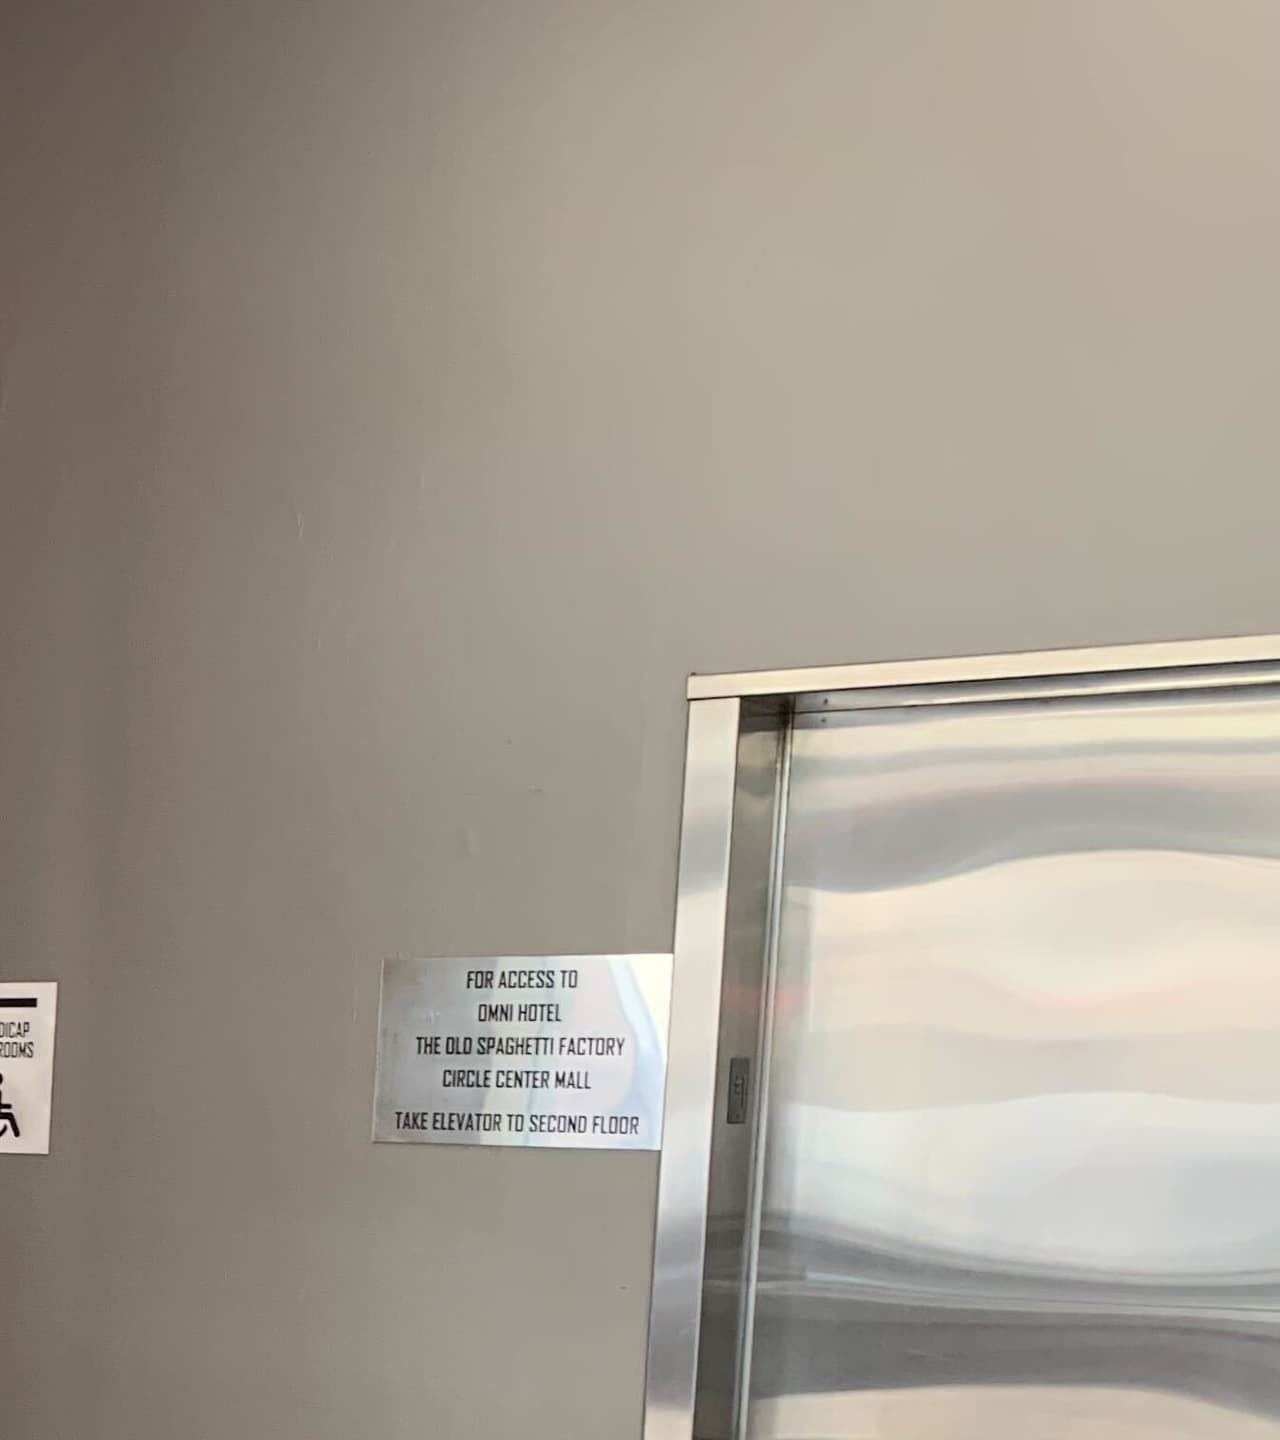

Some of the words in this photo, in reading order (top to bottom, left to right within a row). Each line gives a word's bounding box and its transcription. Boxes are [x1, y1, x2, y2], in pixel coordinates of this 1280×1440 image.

[467, 970, 493, 989] FOR
[498, 970, 555, 988] ACCESS
[561, 970, 578, 988] TO
[478, 1003, 513, 1022] OMNI
[517, 1003, 562, 1022] HOTEL
[416, 1036, 441, 1055] THE
[445, 1037, 472, 1055] OLD
[477, 1037, 554, 1056] SPAGHETTI
[559, 1037, 625, 1056] FACTORY
[442, 1069, 491, 1088] CIRCLE
[496, 1070, 550, 1089] CENTER
[554, 1071, 592, 1089] MALL
[395, 1111, 428, 1130] TAKE
[432, 1112, 502, 1131] ELEVATOR
[506, 1114, 524, 1132] TO
[529, 1114, 587, 1134] SECOND
[592, 1115, 639, 1134] FLOOR
